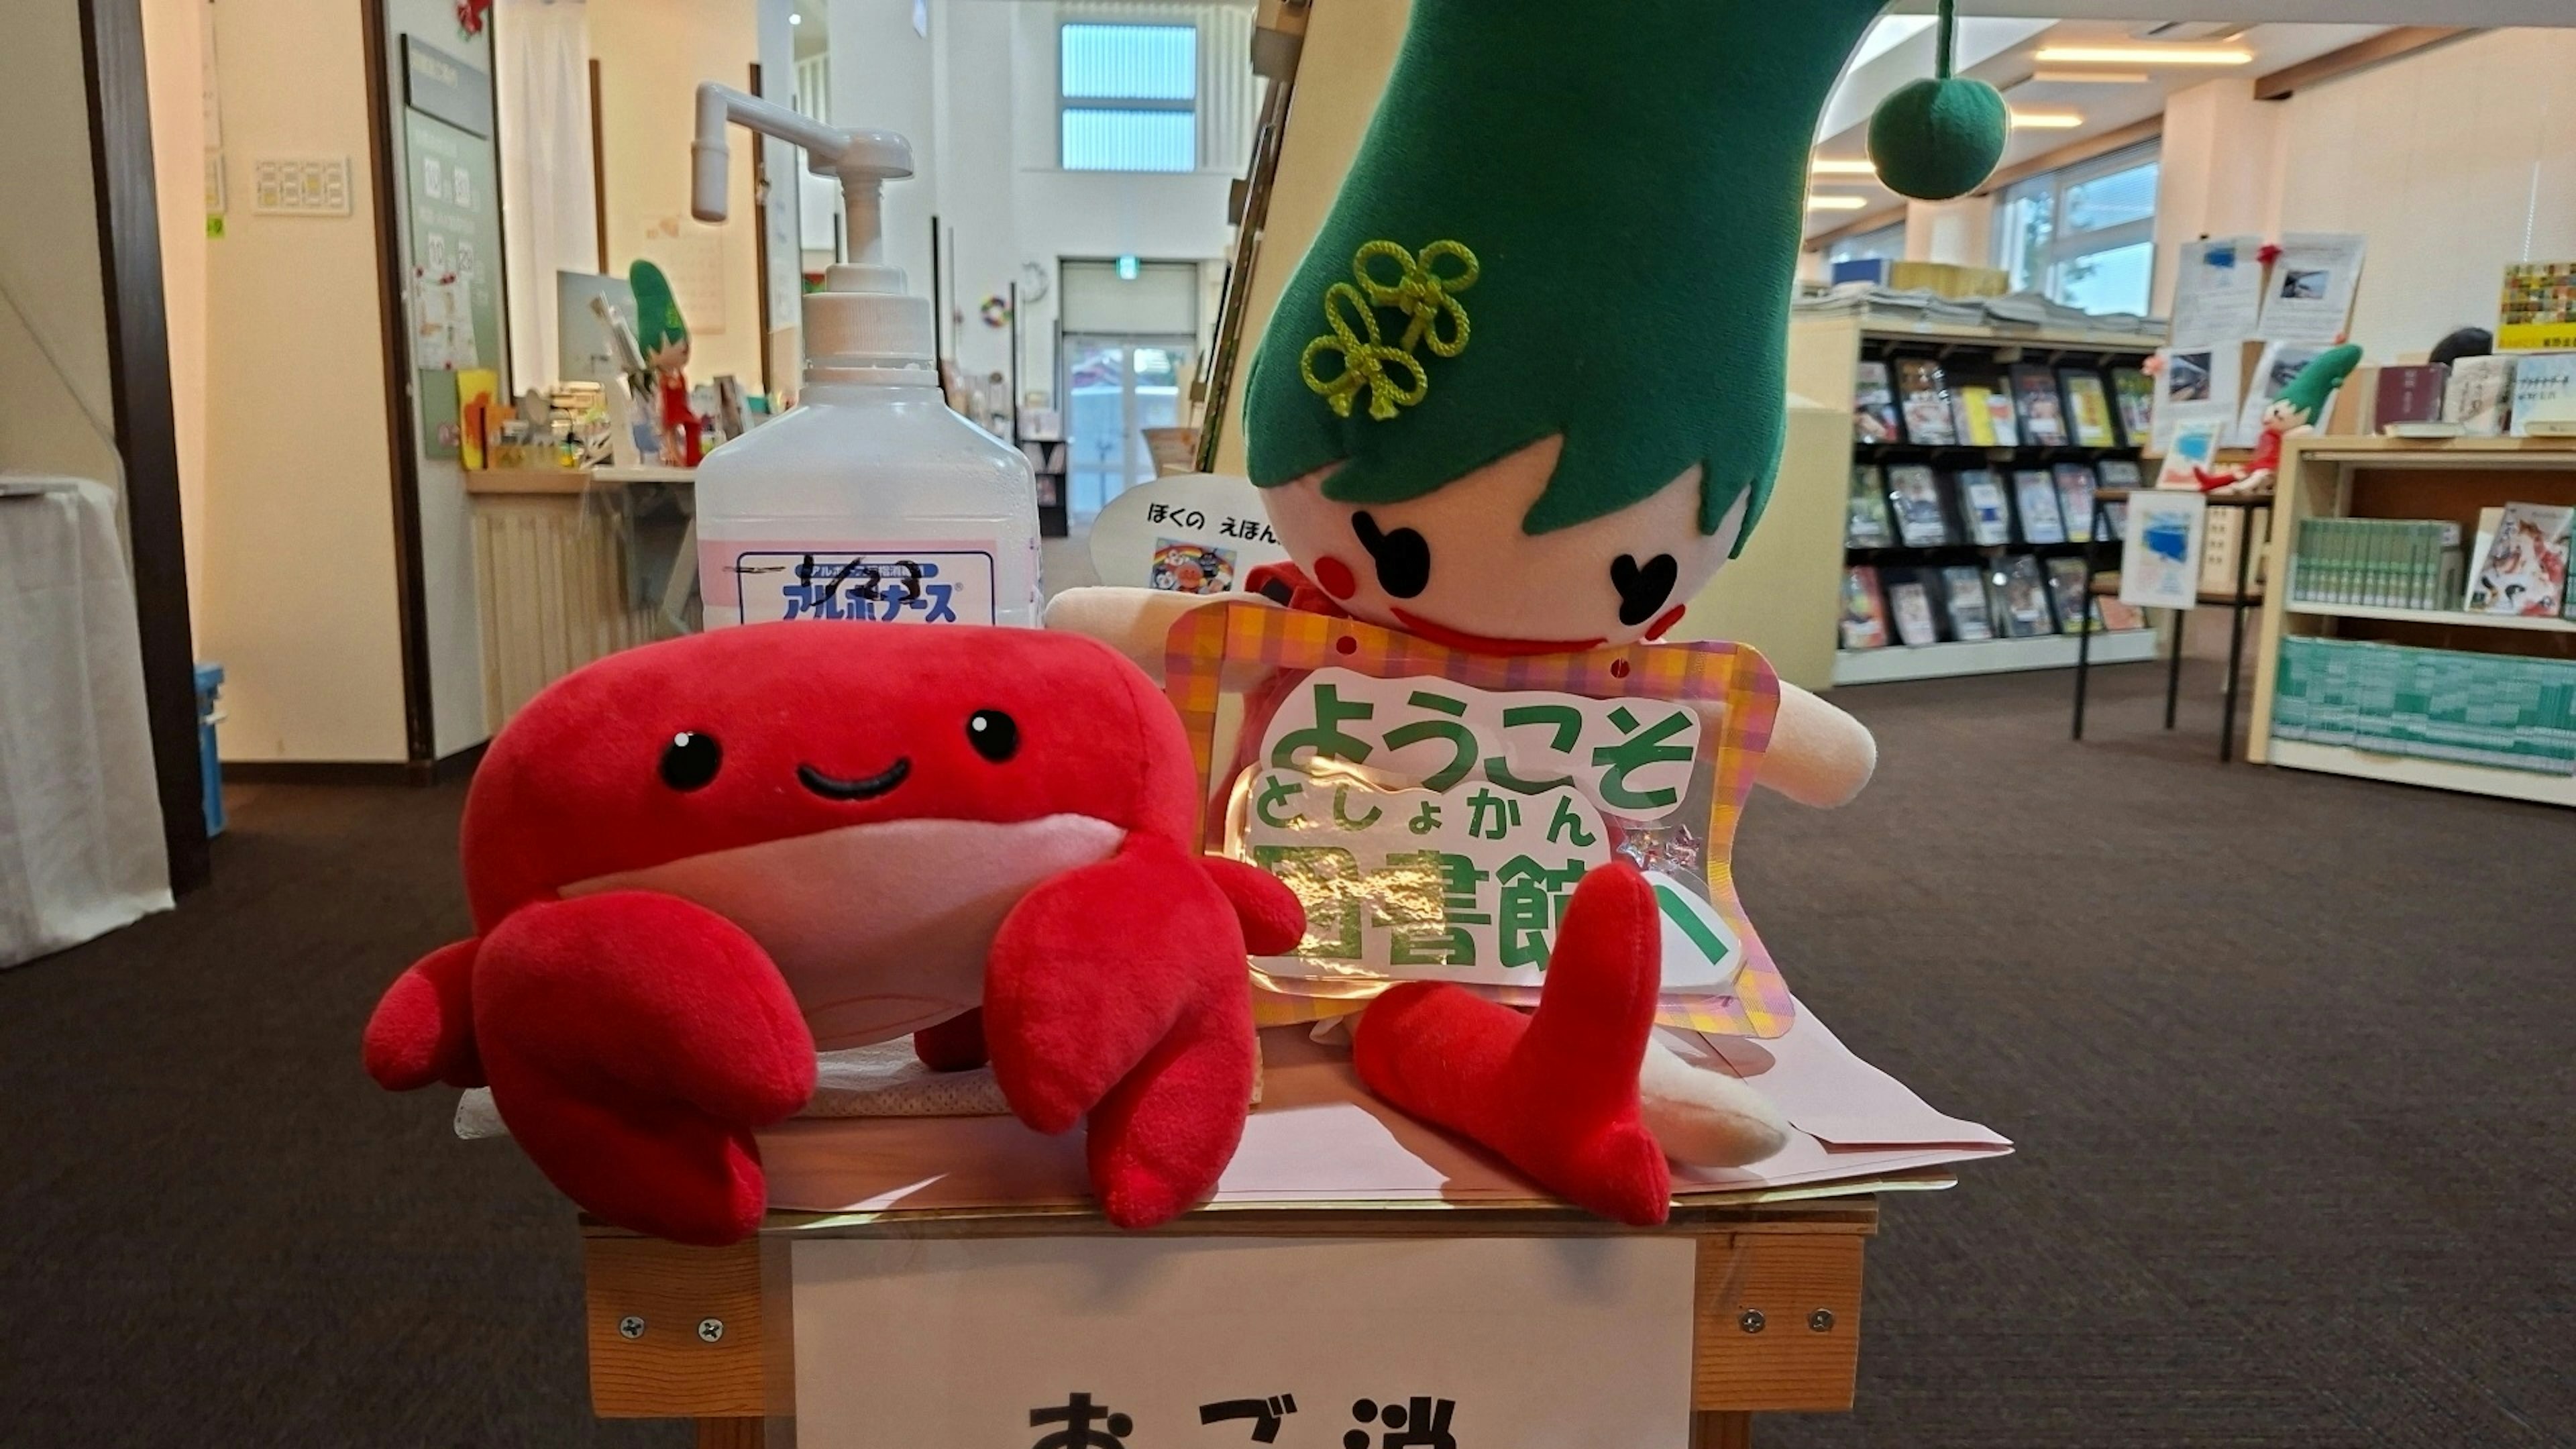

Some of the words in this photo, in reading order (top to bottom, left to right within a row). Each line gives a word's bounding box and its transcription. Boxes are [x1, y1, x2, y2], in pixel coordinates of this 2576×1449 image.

[1271, 684, 1695, 810] ようこそ
[1255, 774, 1597, 847] としょかん
